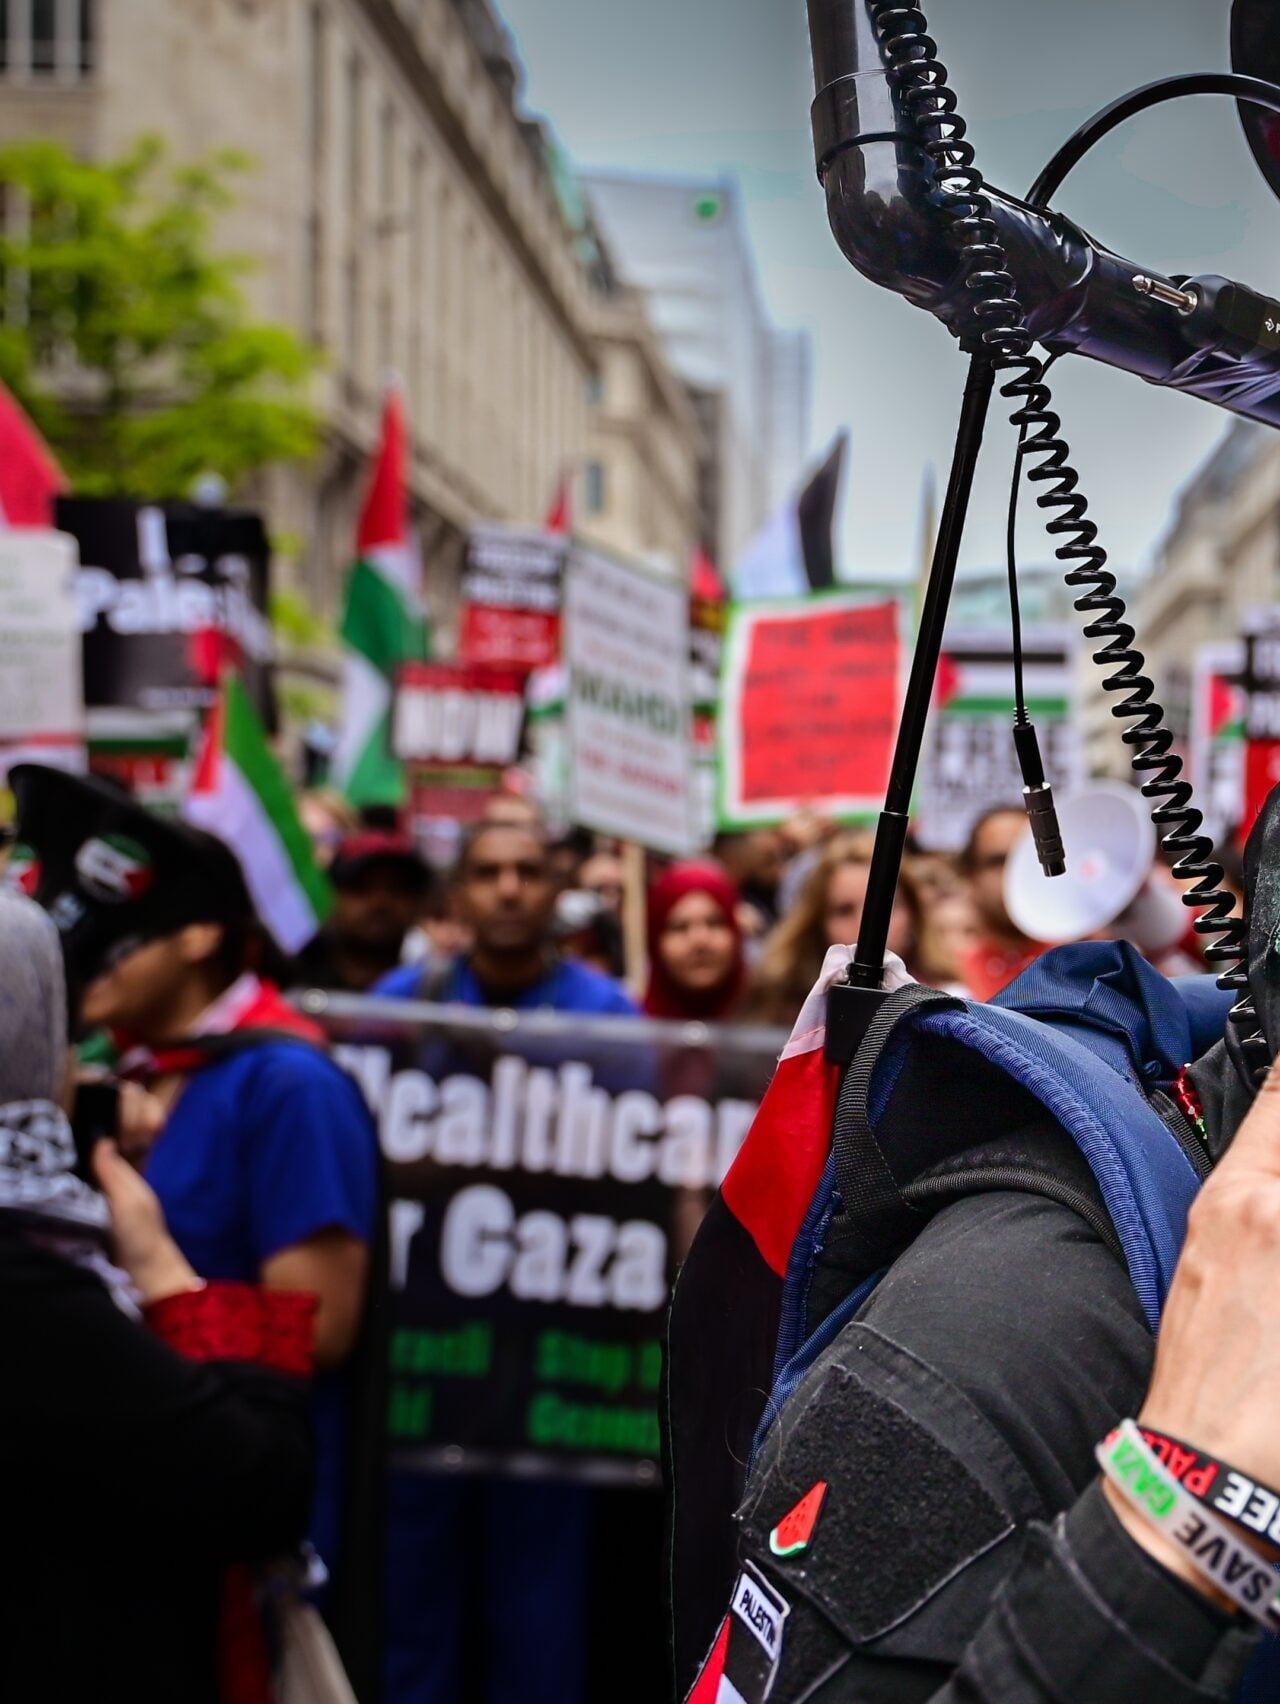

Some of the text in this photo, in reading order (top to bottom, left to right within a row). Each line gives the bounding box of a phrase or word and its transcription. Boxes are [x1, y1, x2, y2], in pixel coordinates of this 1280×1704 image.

[334, 1042, 758, 1190] ealthcar
[440, 1183, 667, 1312] Gaza
[1173, 1510, 1272, 1601] SAVE
